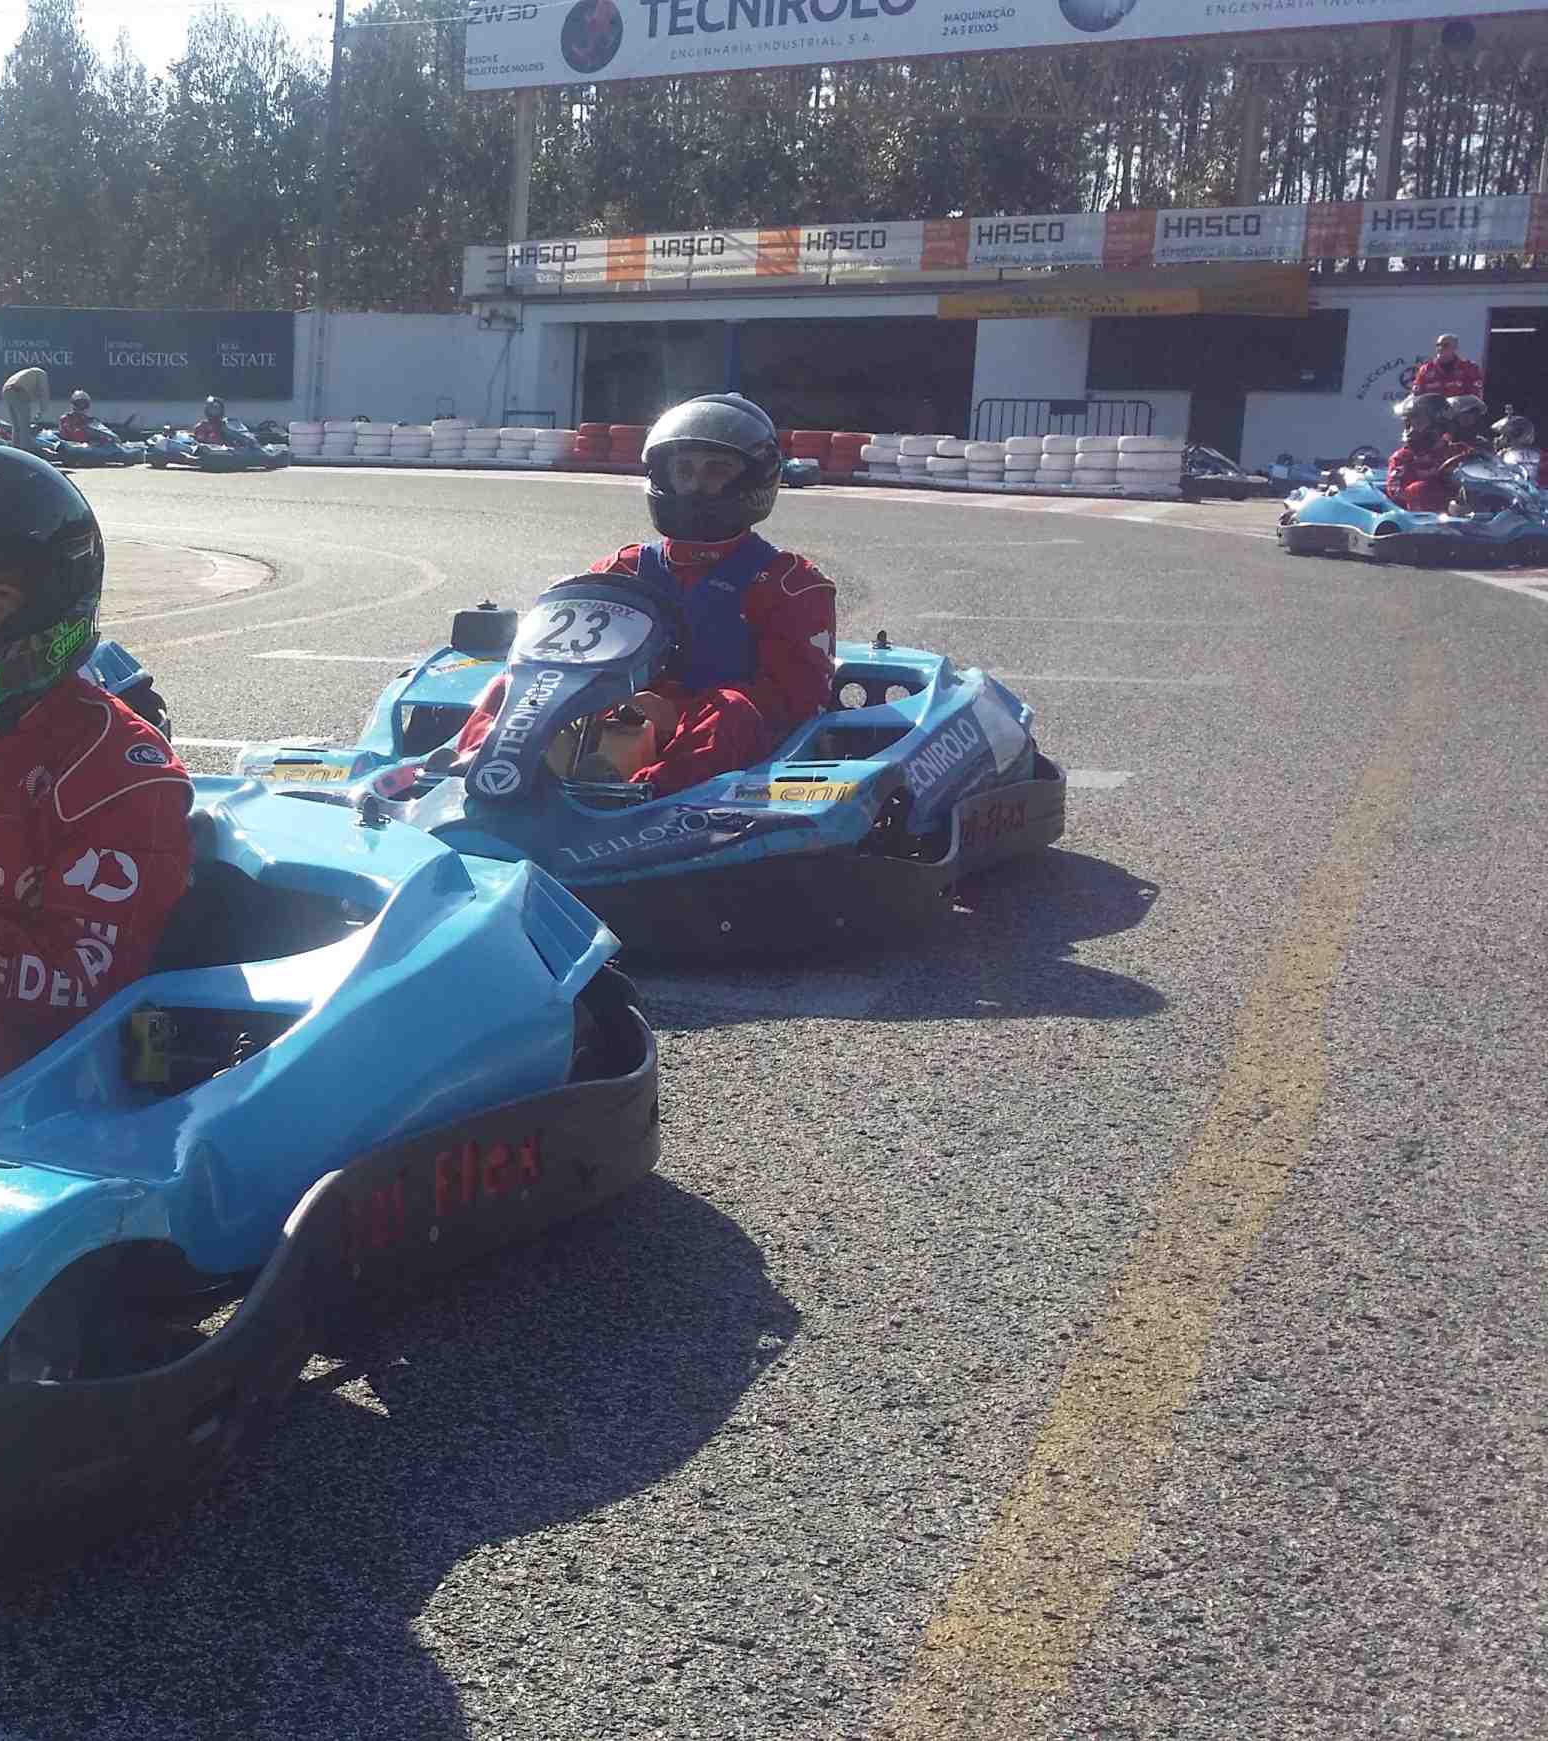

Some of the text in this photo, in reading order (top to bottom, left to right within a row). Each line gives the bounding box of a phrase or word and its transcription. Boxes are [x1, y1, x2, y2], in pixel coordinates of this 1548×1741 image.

[1163, 213, 1261, 239] HASCO
[1370, 205, 1480, 232] HASCO
[807, 229, 887, 252] HASCO
[977, 222, 1065, 245] HASCO
[512, 244, 577, 266] HASCO
[653, 236, 725, 258] HASCO
[3, 350, 73, 366] FINANCE
[108, 352, 189, 367] LOGISTICS
[221, 353, 277, 367] ESTATE
[532, 607, 612, 653] 23
[491, 669, 564, 758] TECNIROLO
[779, 785, 848, 801] eni
